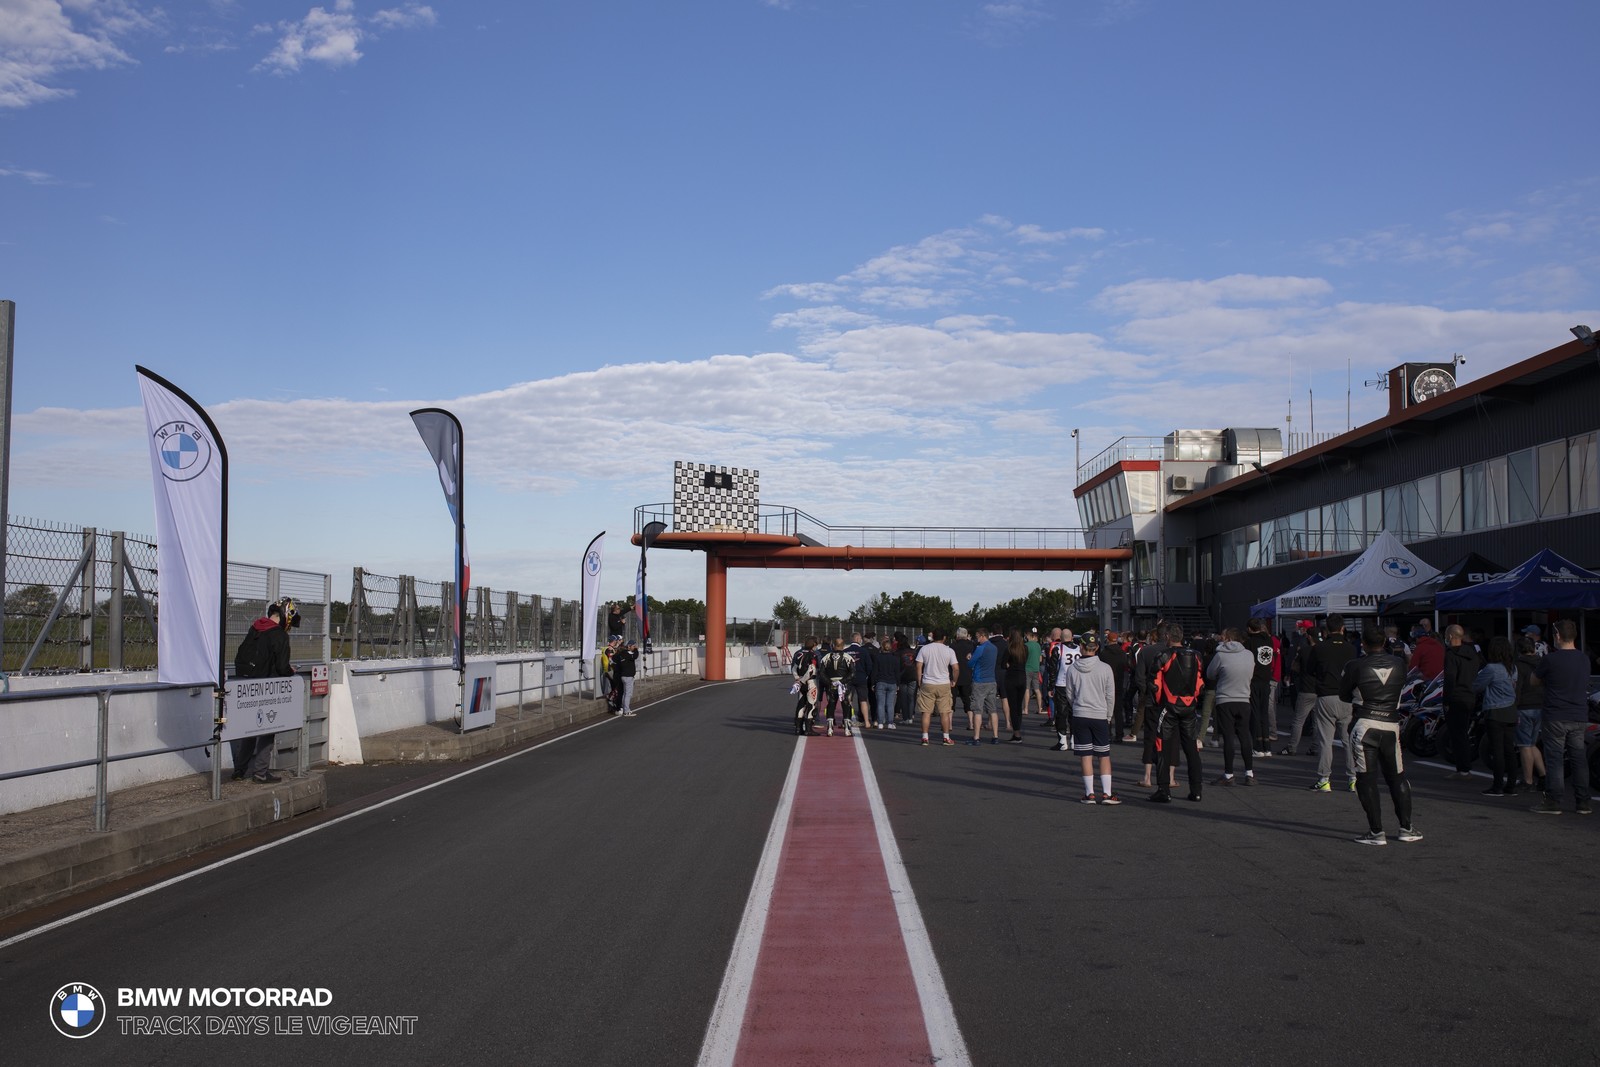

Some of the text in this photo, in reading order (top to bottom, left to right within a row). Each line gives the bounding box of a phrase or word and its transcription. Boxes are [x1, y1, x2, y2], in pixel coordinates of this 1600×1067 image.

[1468, 573, 1504, 582] BM
[1281, 596, 1322, 608] BMW MOTORRAD
[237, 680, 292, 698] BAYERN POITIERS
[237, 700, 259, 709] Concession
